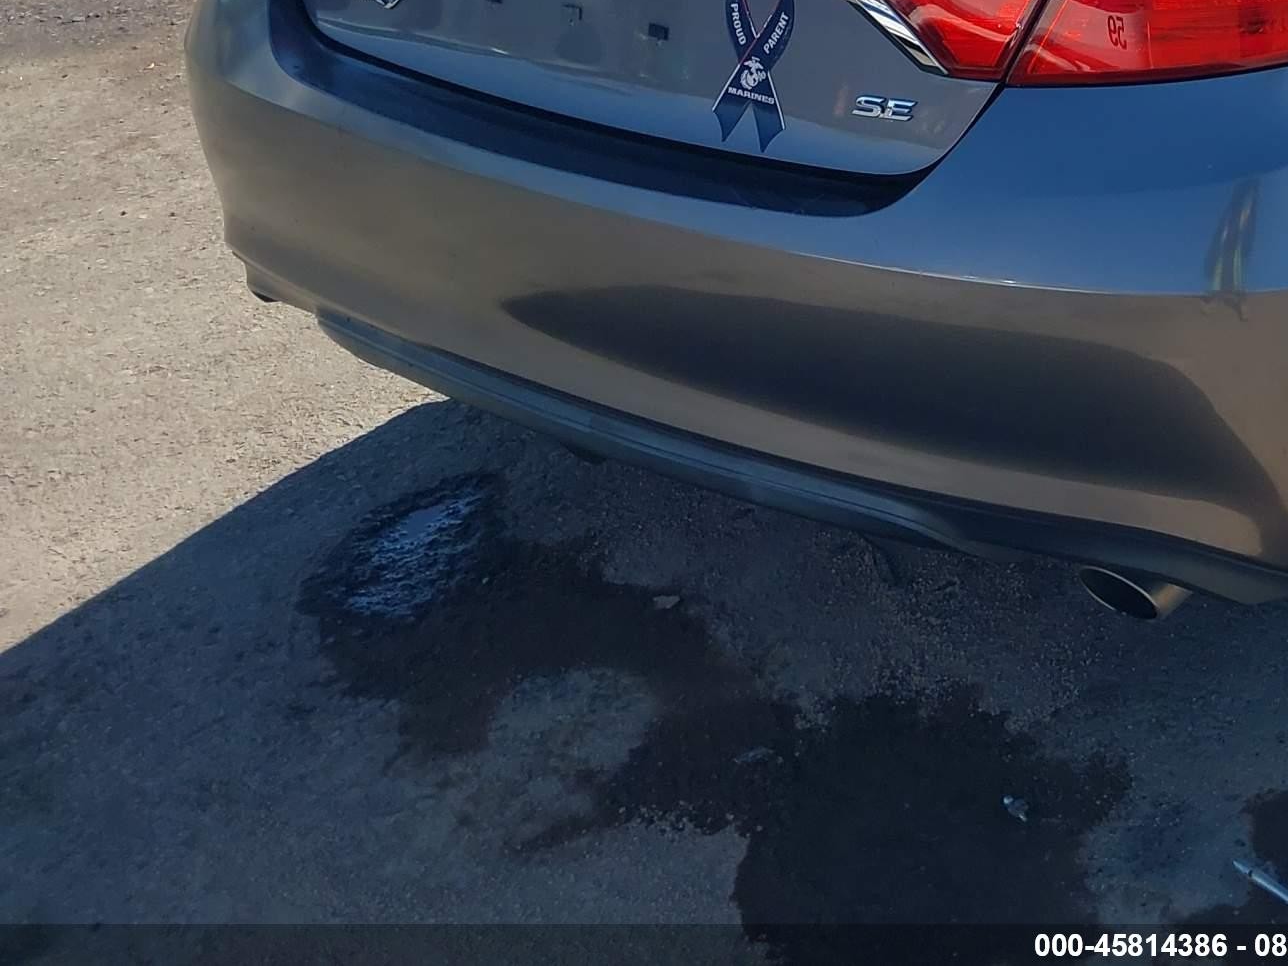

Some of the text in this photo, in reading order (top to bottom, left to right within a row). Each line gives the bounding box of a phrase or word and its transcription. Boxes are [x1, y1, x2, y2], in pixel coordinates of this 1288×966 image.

[730, 2, 789, 54] PROUD PARENT
[727, 86, 775, 105] MARINES
[852, 95, 917, 121] SE
